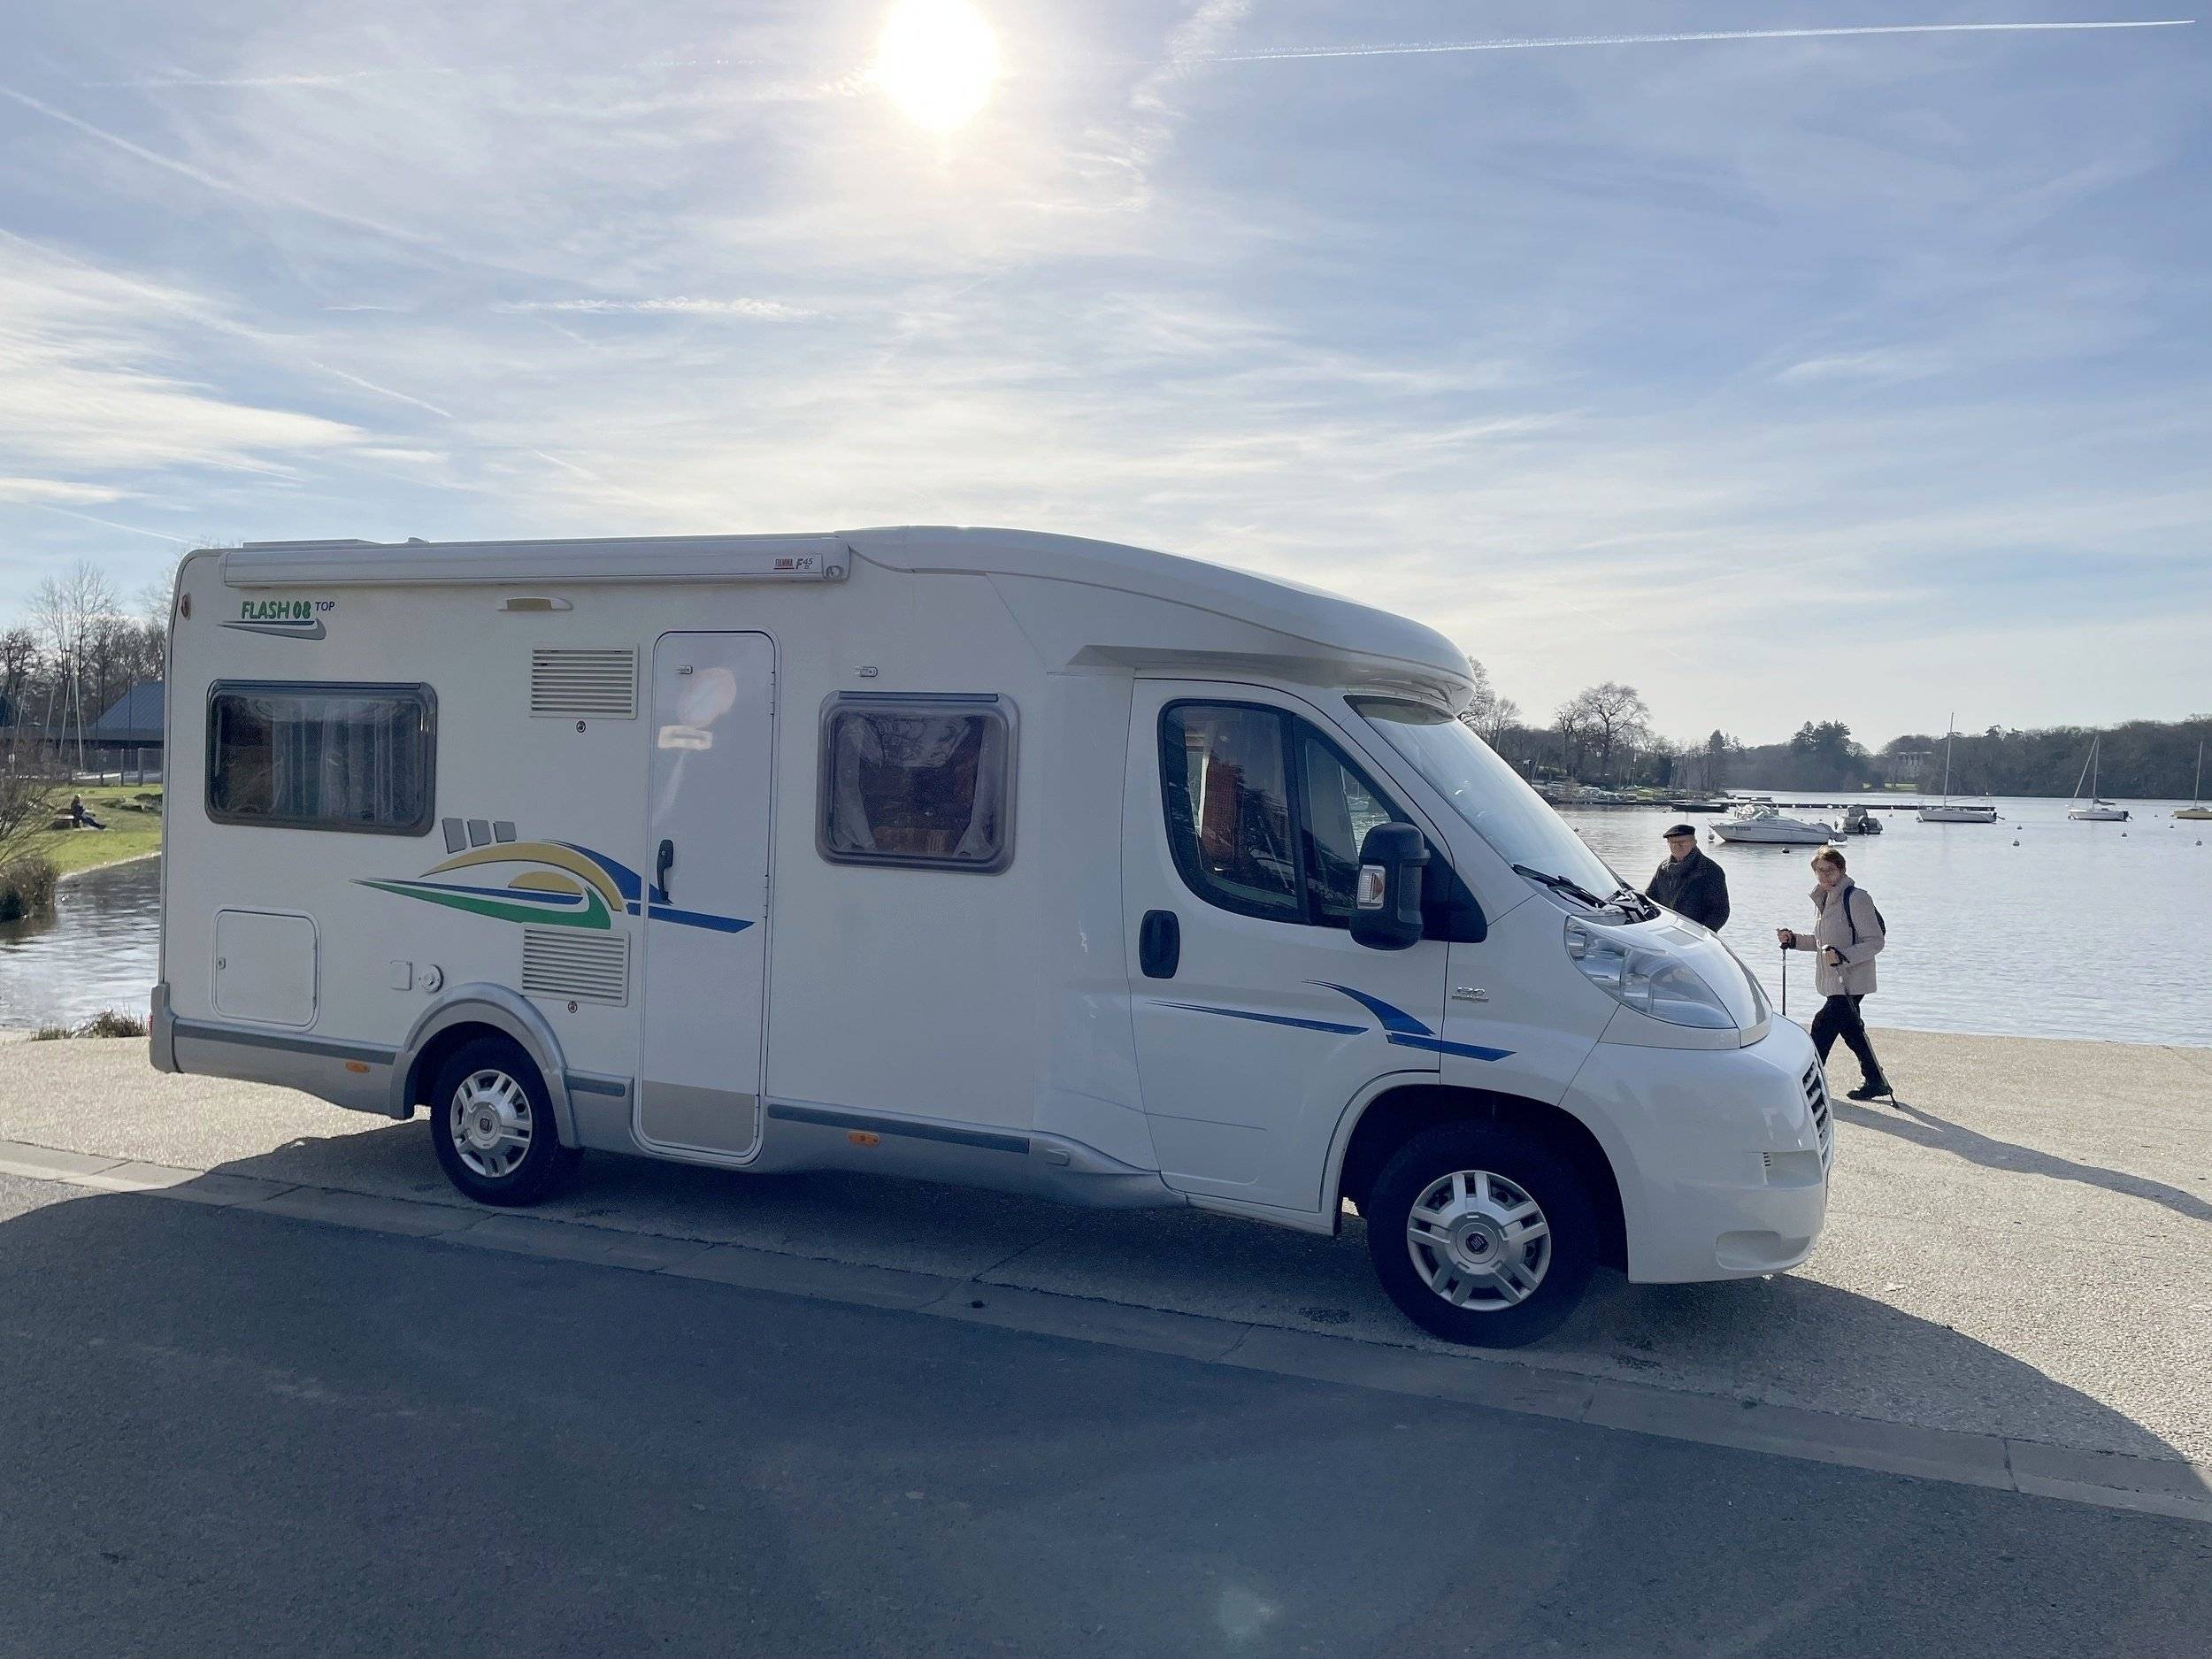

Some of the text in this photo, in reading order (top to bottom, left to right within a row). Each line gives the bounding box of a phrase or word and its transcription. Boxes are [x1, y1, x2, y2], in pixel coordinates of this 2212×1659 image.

[241, 601, 335, 619] FLASH 08 TOP
